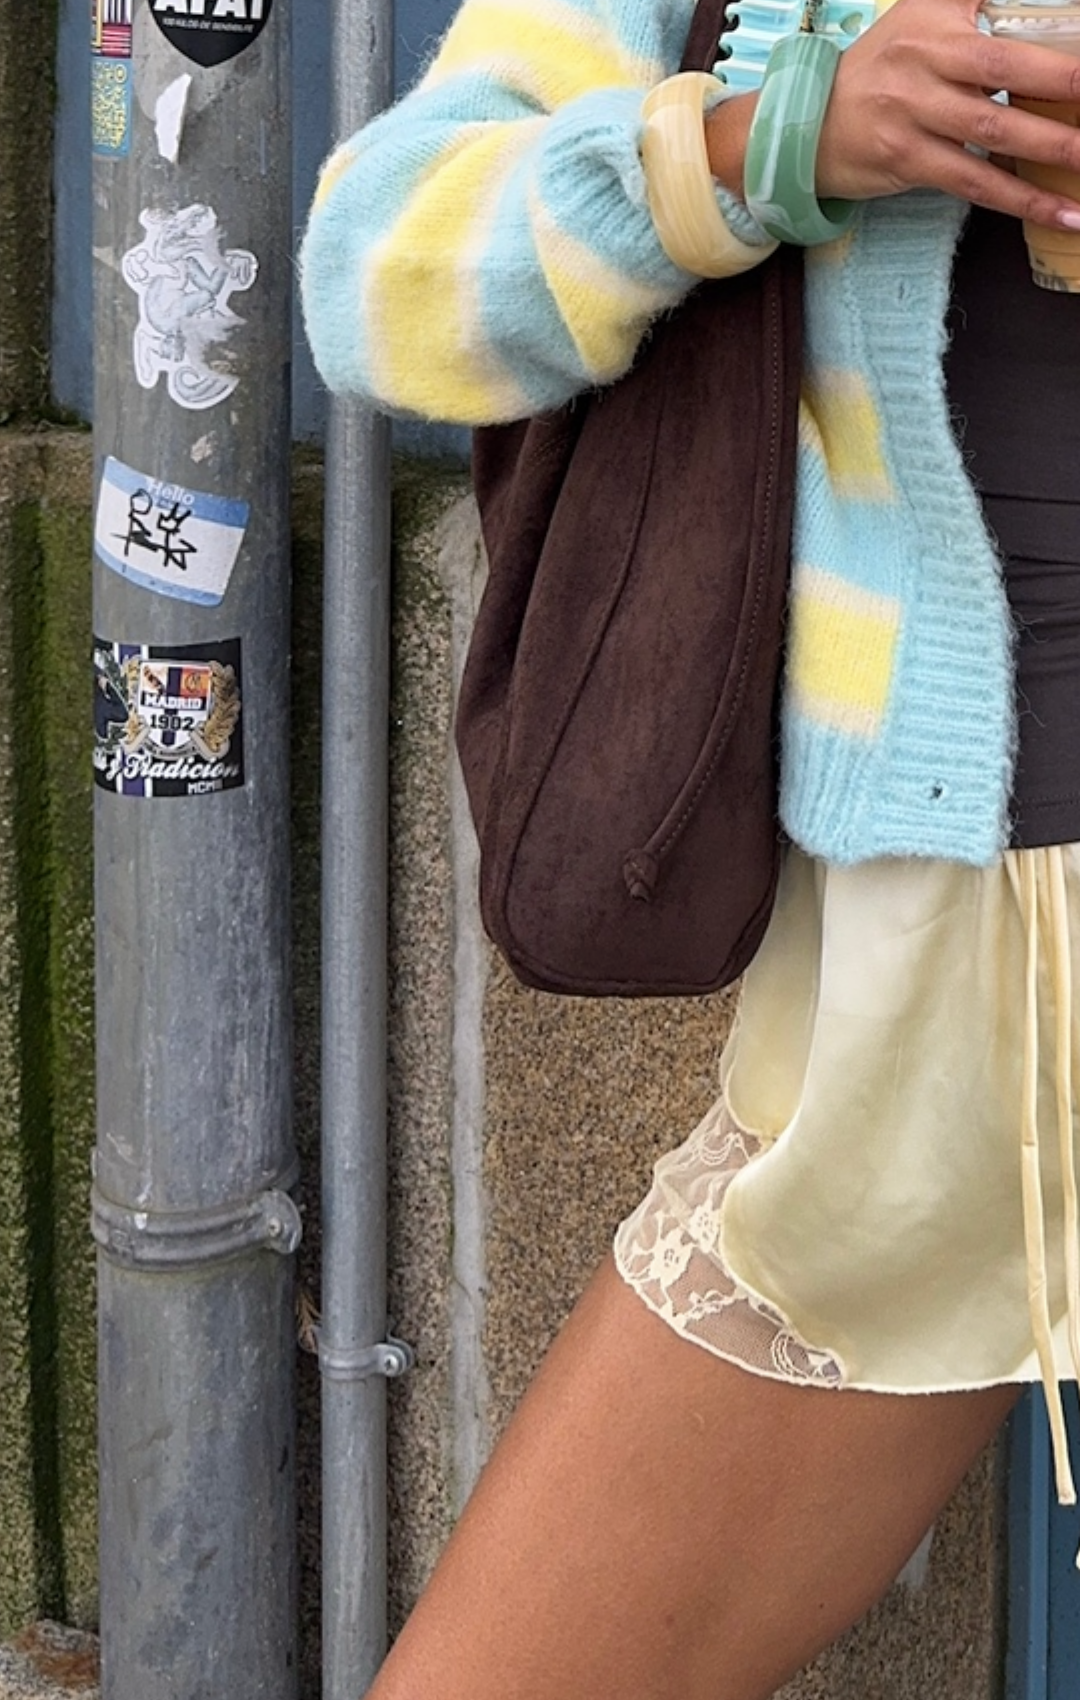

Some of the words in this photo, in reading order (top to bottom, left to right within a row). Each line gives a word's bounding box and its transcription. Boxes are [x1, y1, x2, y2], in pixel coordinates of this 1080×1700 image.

[147, 479, 196, 507] Hello
[145, 695, 202, 709] MADRID
[149, 714, 195, 731] 1902
